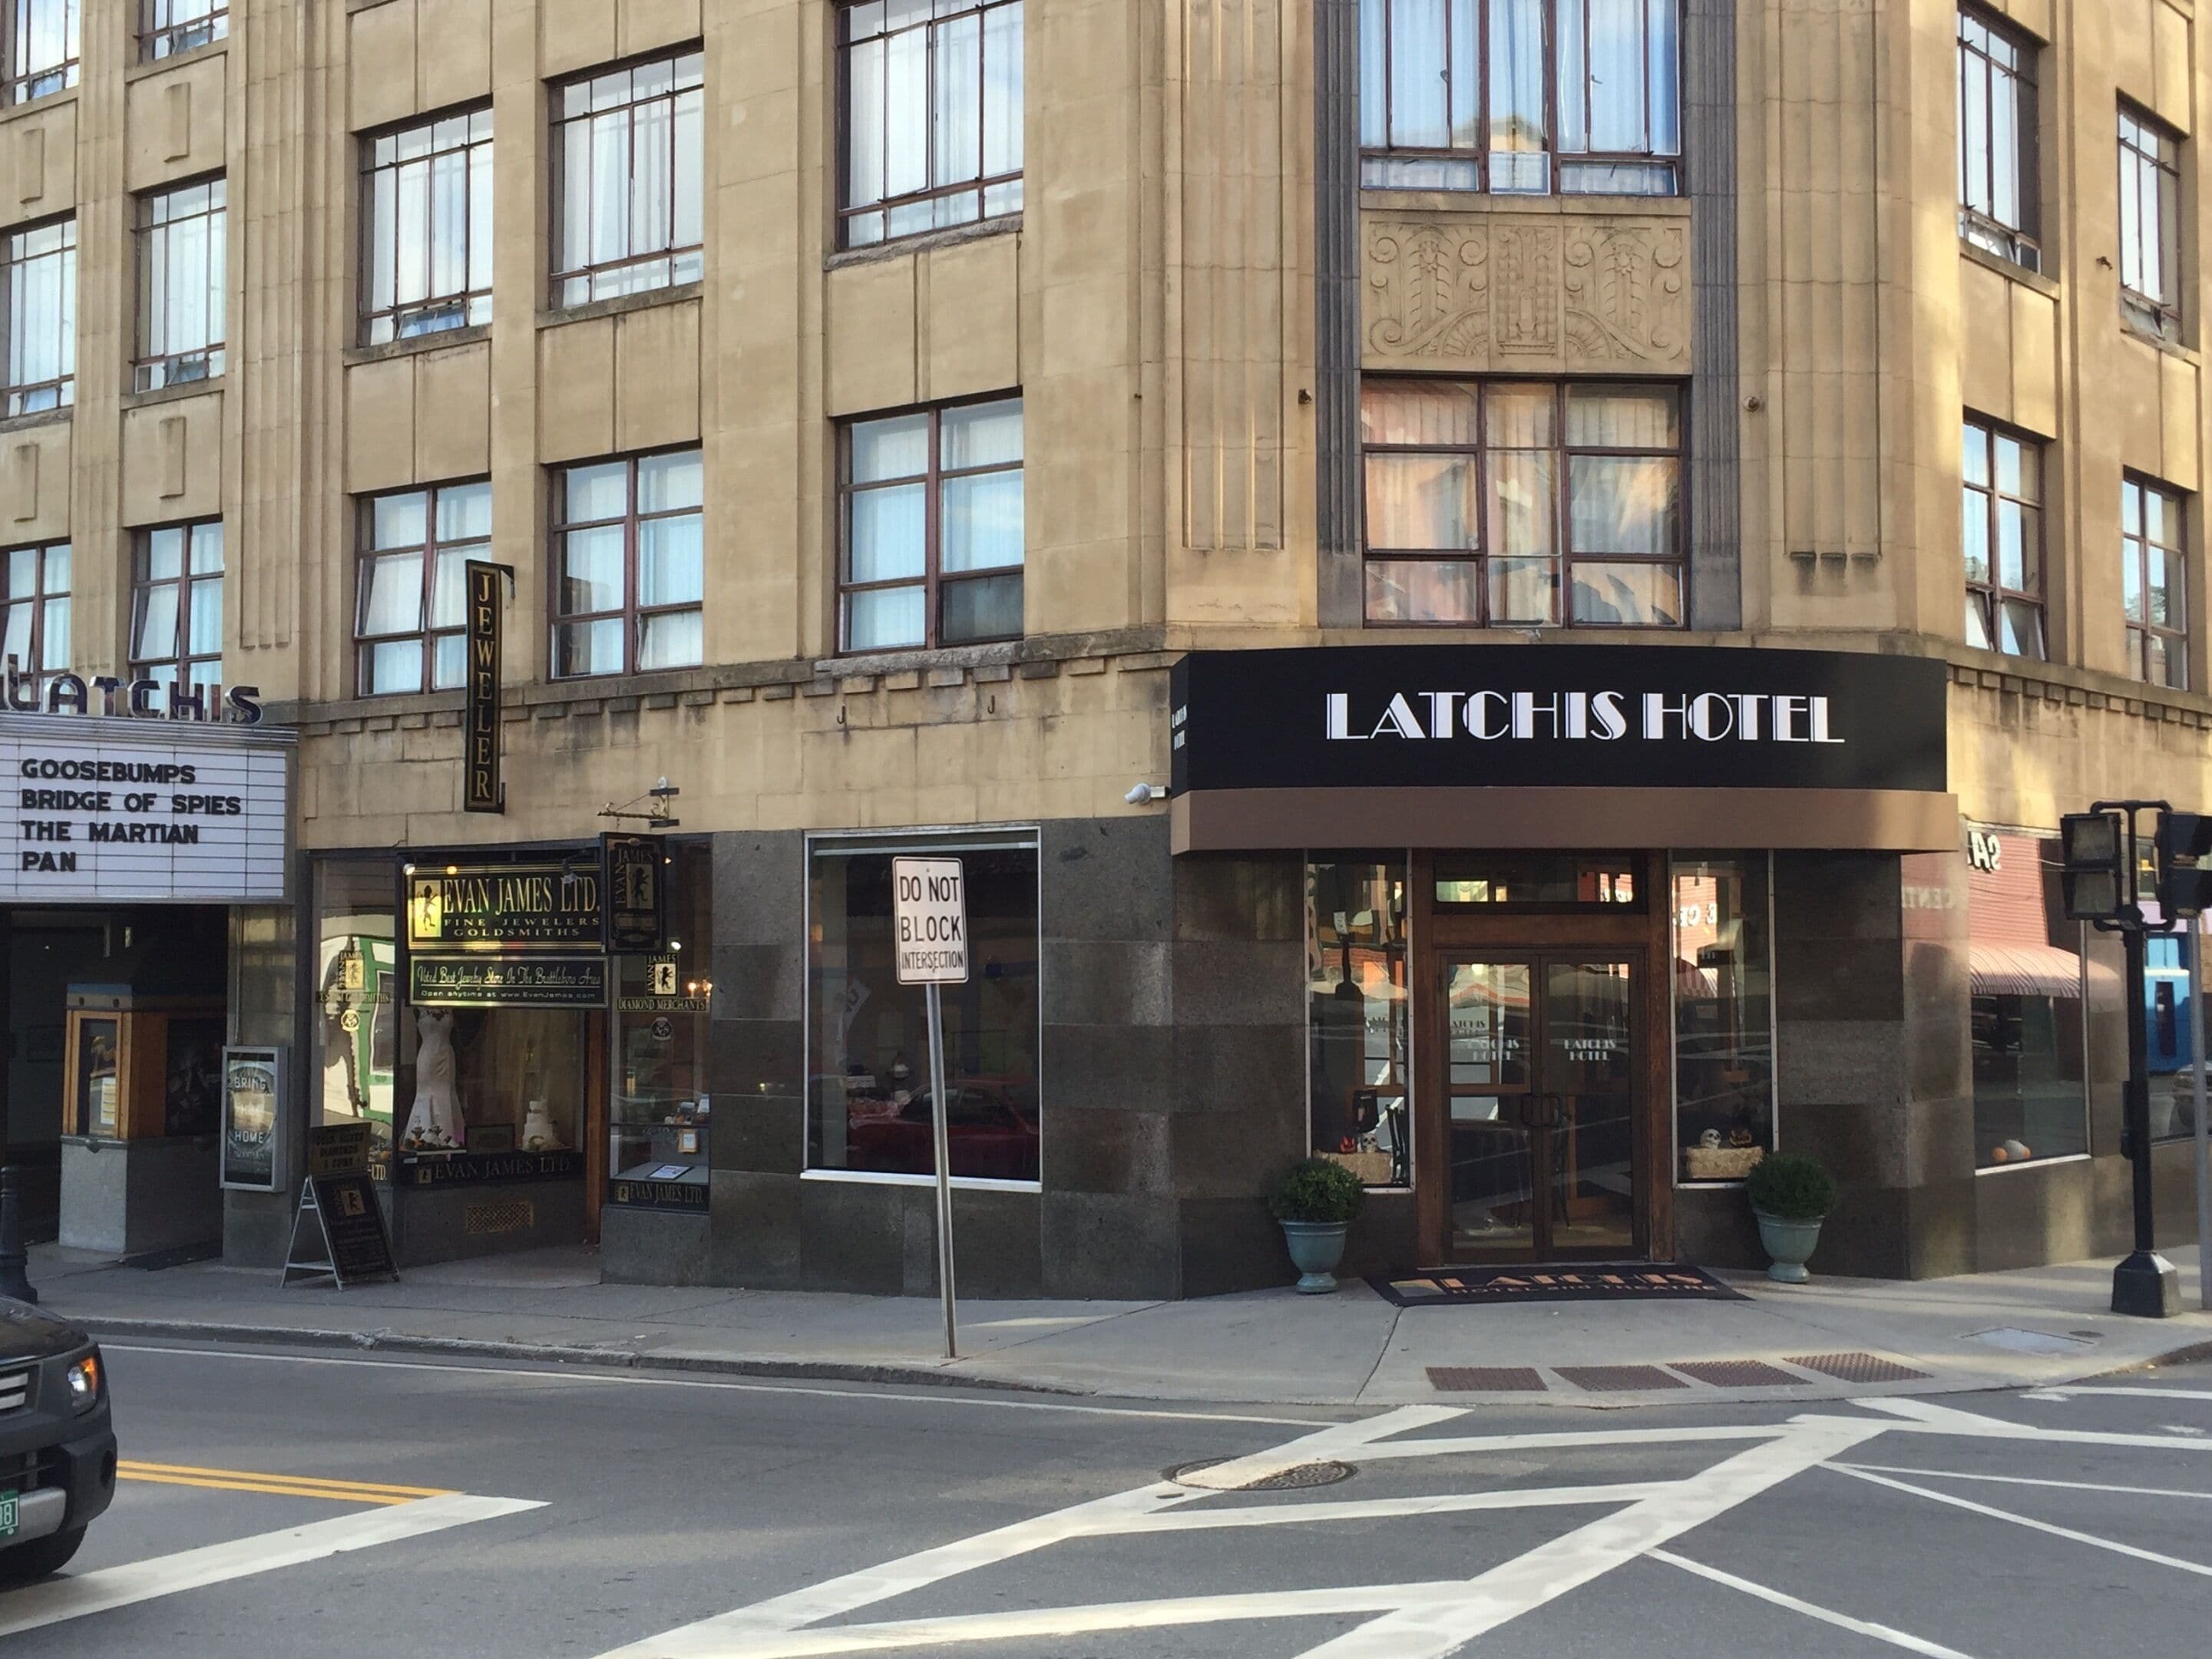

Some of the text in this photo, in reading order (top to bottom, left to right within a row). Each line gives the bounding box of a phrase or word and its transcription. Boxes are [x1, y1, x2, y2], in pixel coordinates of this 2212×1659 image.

[3, 653, 263, 724] LATCHIS
[474, 574, 494, 798] JEWELER
[1326, 691, 1845, 743] LATCHIS HOTEL
[21, 758, 197, 785] GOOSEBUMPS
[21, 788, 242, 816] BRIDGE OF SPIES
[21, 820, 199, 844] THE MARTIAN
[21, 851, 77, 873] PAN
[443, 877, 601, 915] EVAN JAMES LTD.
[900, 876, 959, 902] DO NOT
[444, 917, 600, 927] FINE JEWELERS
[454, 927, 580, 937] GOLDSMITHS
[901, 915, 962, 943] BLOCK
[649, 954, 676, 963] JAMES
[901, 950, 964, 970] INTERSECTION
[438, 966, 456, 983] Best
[484, 966, 504, 984] Store
[517, 967, 533, 984] The
[618, 998, 706, 1010] DIAMOND MERCHANTS
[234, 1077, 266, 1089] BRING
[234, 1131, 264, 1144] HOME
[372, 1163, 388, 1181] LTD.
[435, 1162, 479, 1180] EVAN
[484, 1157, 534, 1179] JAMES
[629, 1181, 653, 1199] EVAN
[654, 1183, 683, 1204] JAMES
